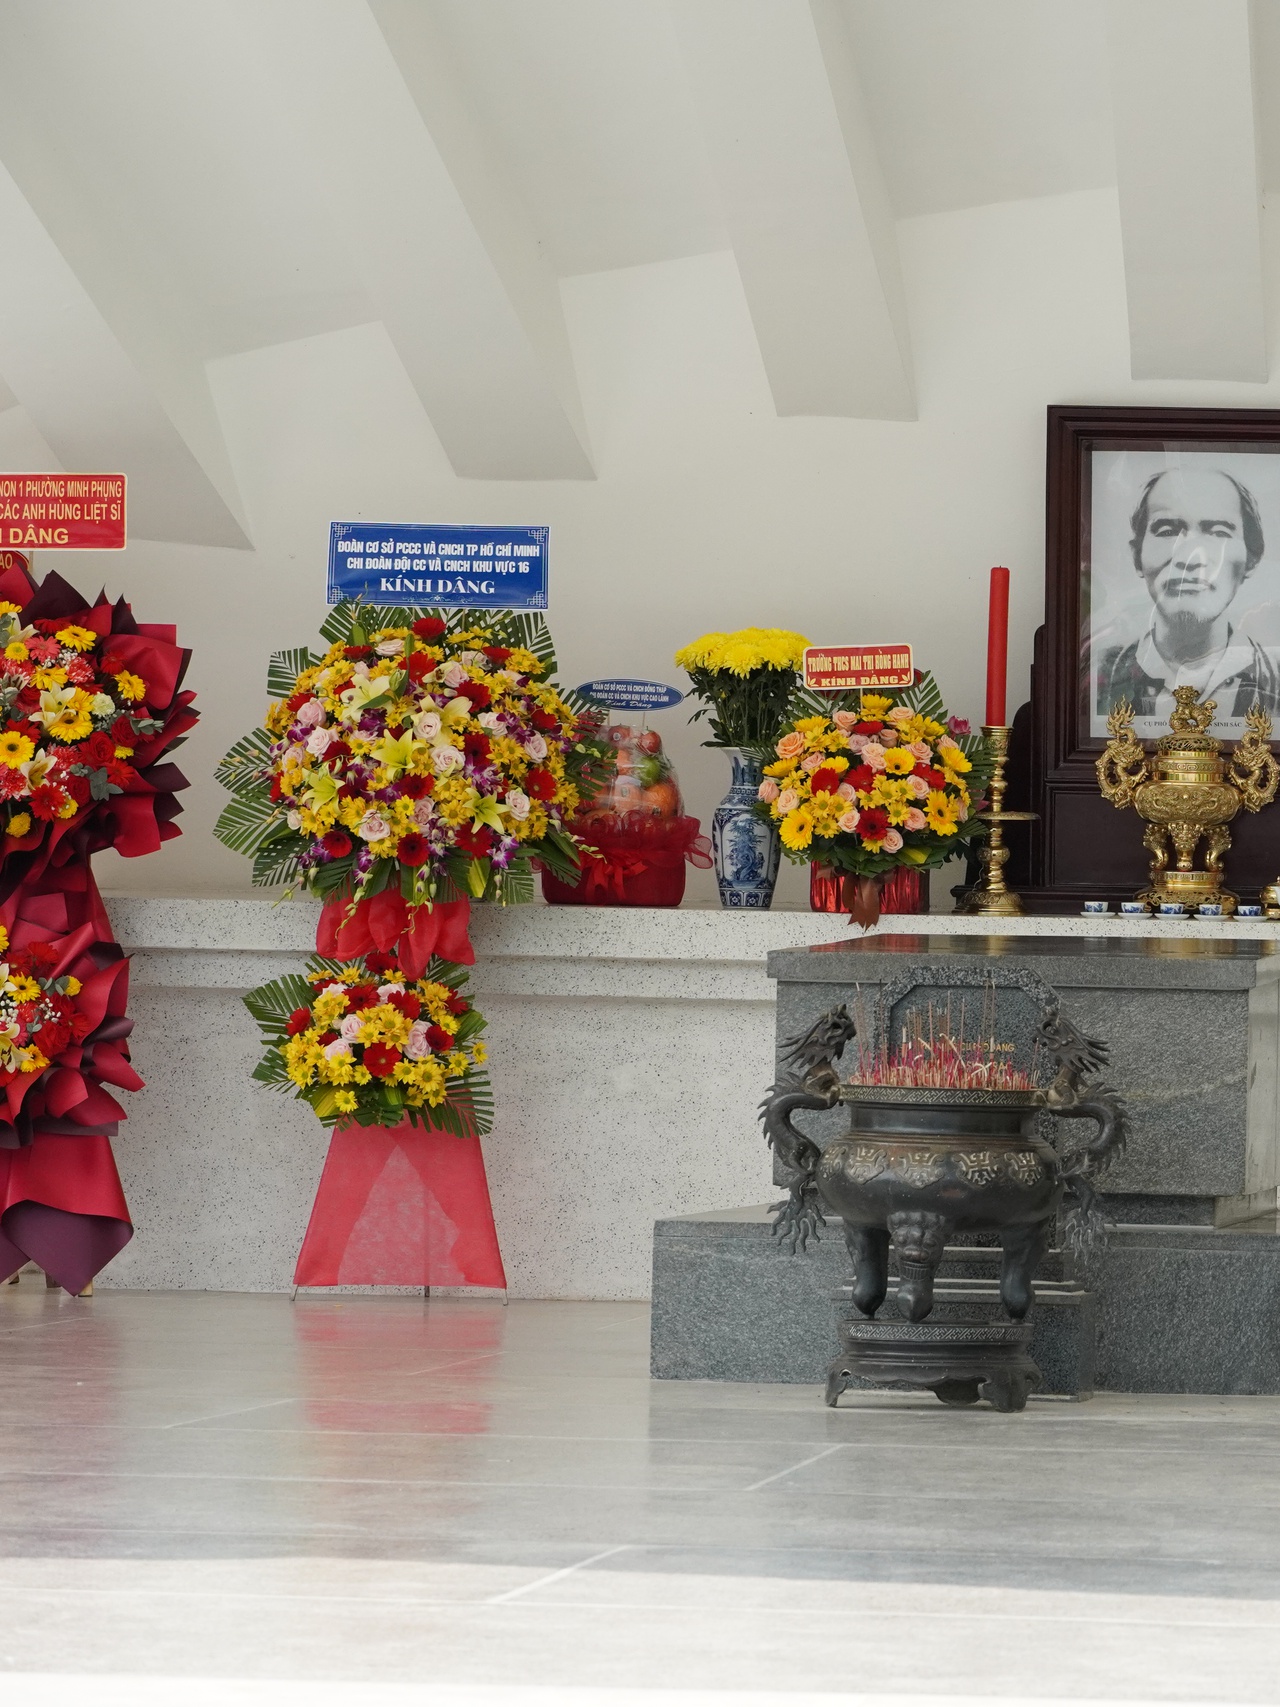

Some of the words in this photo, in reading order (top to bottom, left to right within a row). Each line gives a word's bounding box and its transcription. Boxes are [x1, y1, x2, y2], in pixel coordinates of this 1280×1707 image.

[19, 481, 23, 498] 1
[25, 476, 65, 498] PHƯỜNG
[67, 481, 89, 498] MINH
[91, 481, 122, 502] PHỤNG
[22, 504, 46, 520] ANH
[48, 499, 81, 520] HÙNG
[84, 502, 108, 524] LIỆT
[110, 500, 121, 520] SĨ
[9, 524, 69, 544] DÂNG
[337, 538, 364, 553] ĐOÀN
[365, 541, 380, 553] CƠ
[381, 538, 395, 554] SỞ
[396, 542, 422, 554] PCCC
[423, 541, 436, 555] VÀ
[438, 543, 464, 555] CNCH
[466, 544, 479, 556] TP
[480, 542, 495, 556] HỒ
[495, 542, 512, 556] CHÍ
[513, 545, 540, 557] MINH
[346, 557, 363, 569] CHI
[365, 556, 392, 570] ĐOÀN
[394, 556, 411, 573] ĐỘI
[413, 559, 426, 571] CC
[428, 557, 442, 571] VÀ
[444, 560, 470, 572] CNCH
[472, 560, 493, 573] KHU
[495, 560, 516, 576] VỰC
[518, 561, 530, 573] 16
[380, 575, 432, 593] KÍNH
[437, 576, 495, 594] DÂNG
[807, 653, 832, 672] TRƯỜNG
[833, 655, 849, 671] THCS
[821, 676, 856, 687] KÍNH
[860, 675, 899, 686] DÂNG
